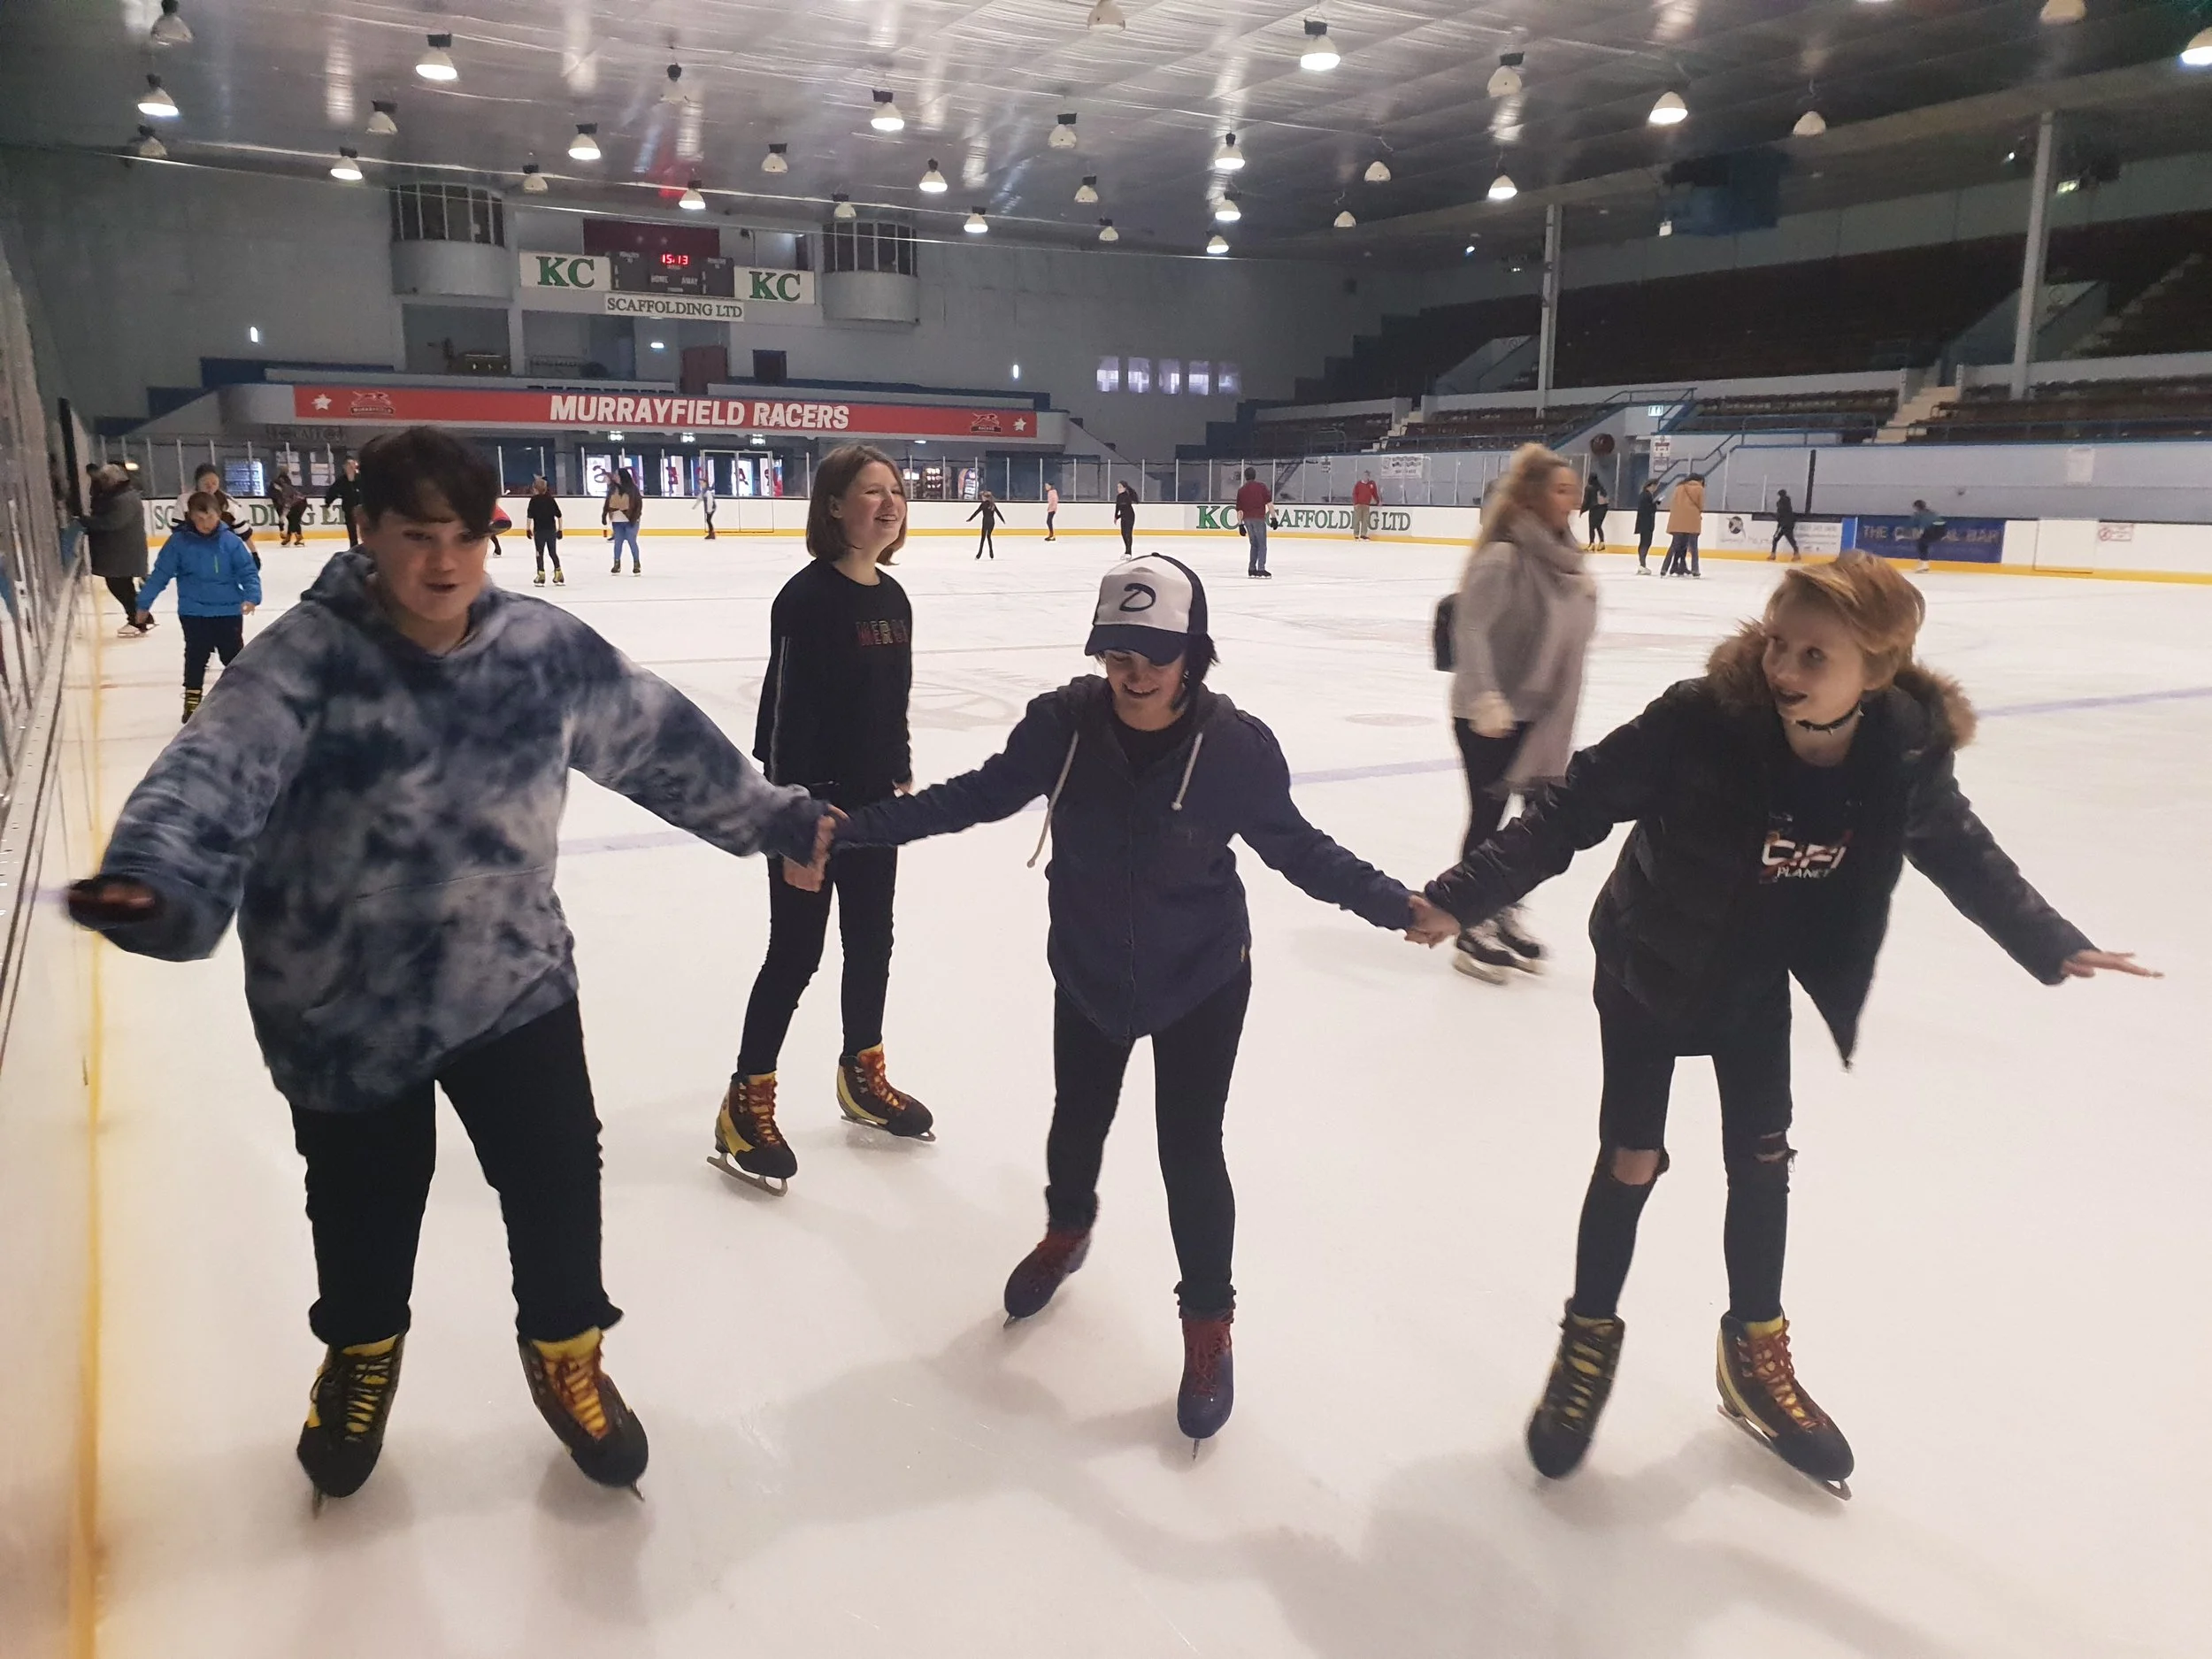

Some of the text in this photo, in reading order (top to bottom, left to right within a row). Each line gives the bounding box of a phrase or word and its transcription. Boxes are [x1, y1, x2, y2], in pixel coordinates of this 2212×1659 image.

[536, 256, 595, 288] KC
[749, 271, 800, 302] KC
[606, 297, 743, 318] SCAFFOLDING LTD
[549, 395, 849, 430] MURRAYFIELD RACERS
[1380, 511, 1411, 531] LTD
[1863, 525, 1887, 539] THE
[1118, 582, 1156, 612] D
